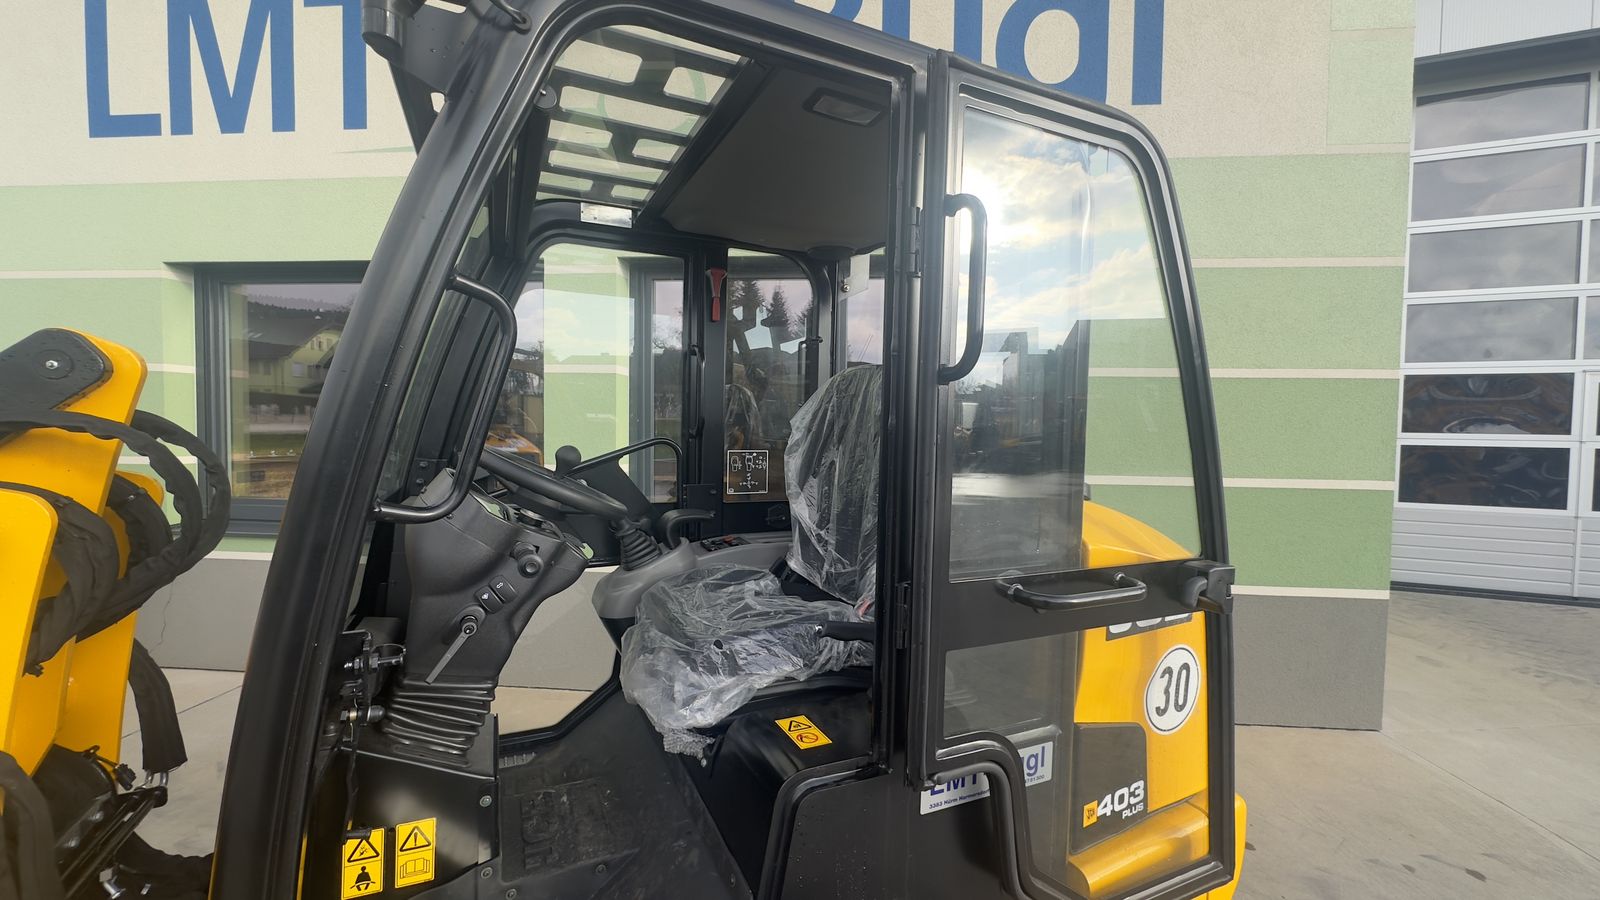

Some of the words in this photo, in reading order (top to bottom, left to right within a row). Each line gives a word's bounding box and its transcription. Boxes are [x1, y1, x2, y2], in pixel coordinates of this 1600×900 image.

[1155, 662, 1190, 717] 30
[1097, 780, 1145, 817] 403
[1122, 803, 1144, 819] PLUS
